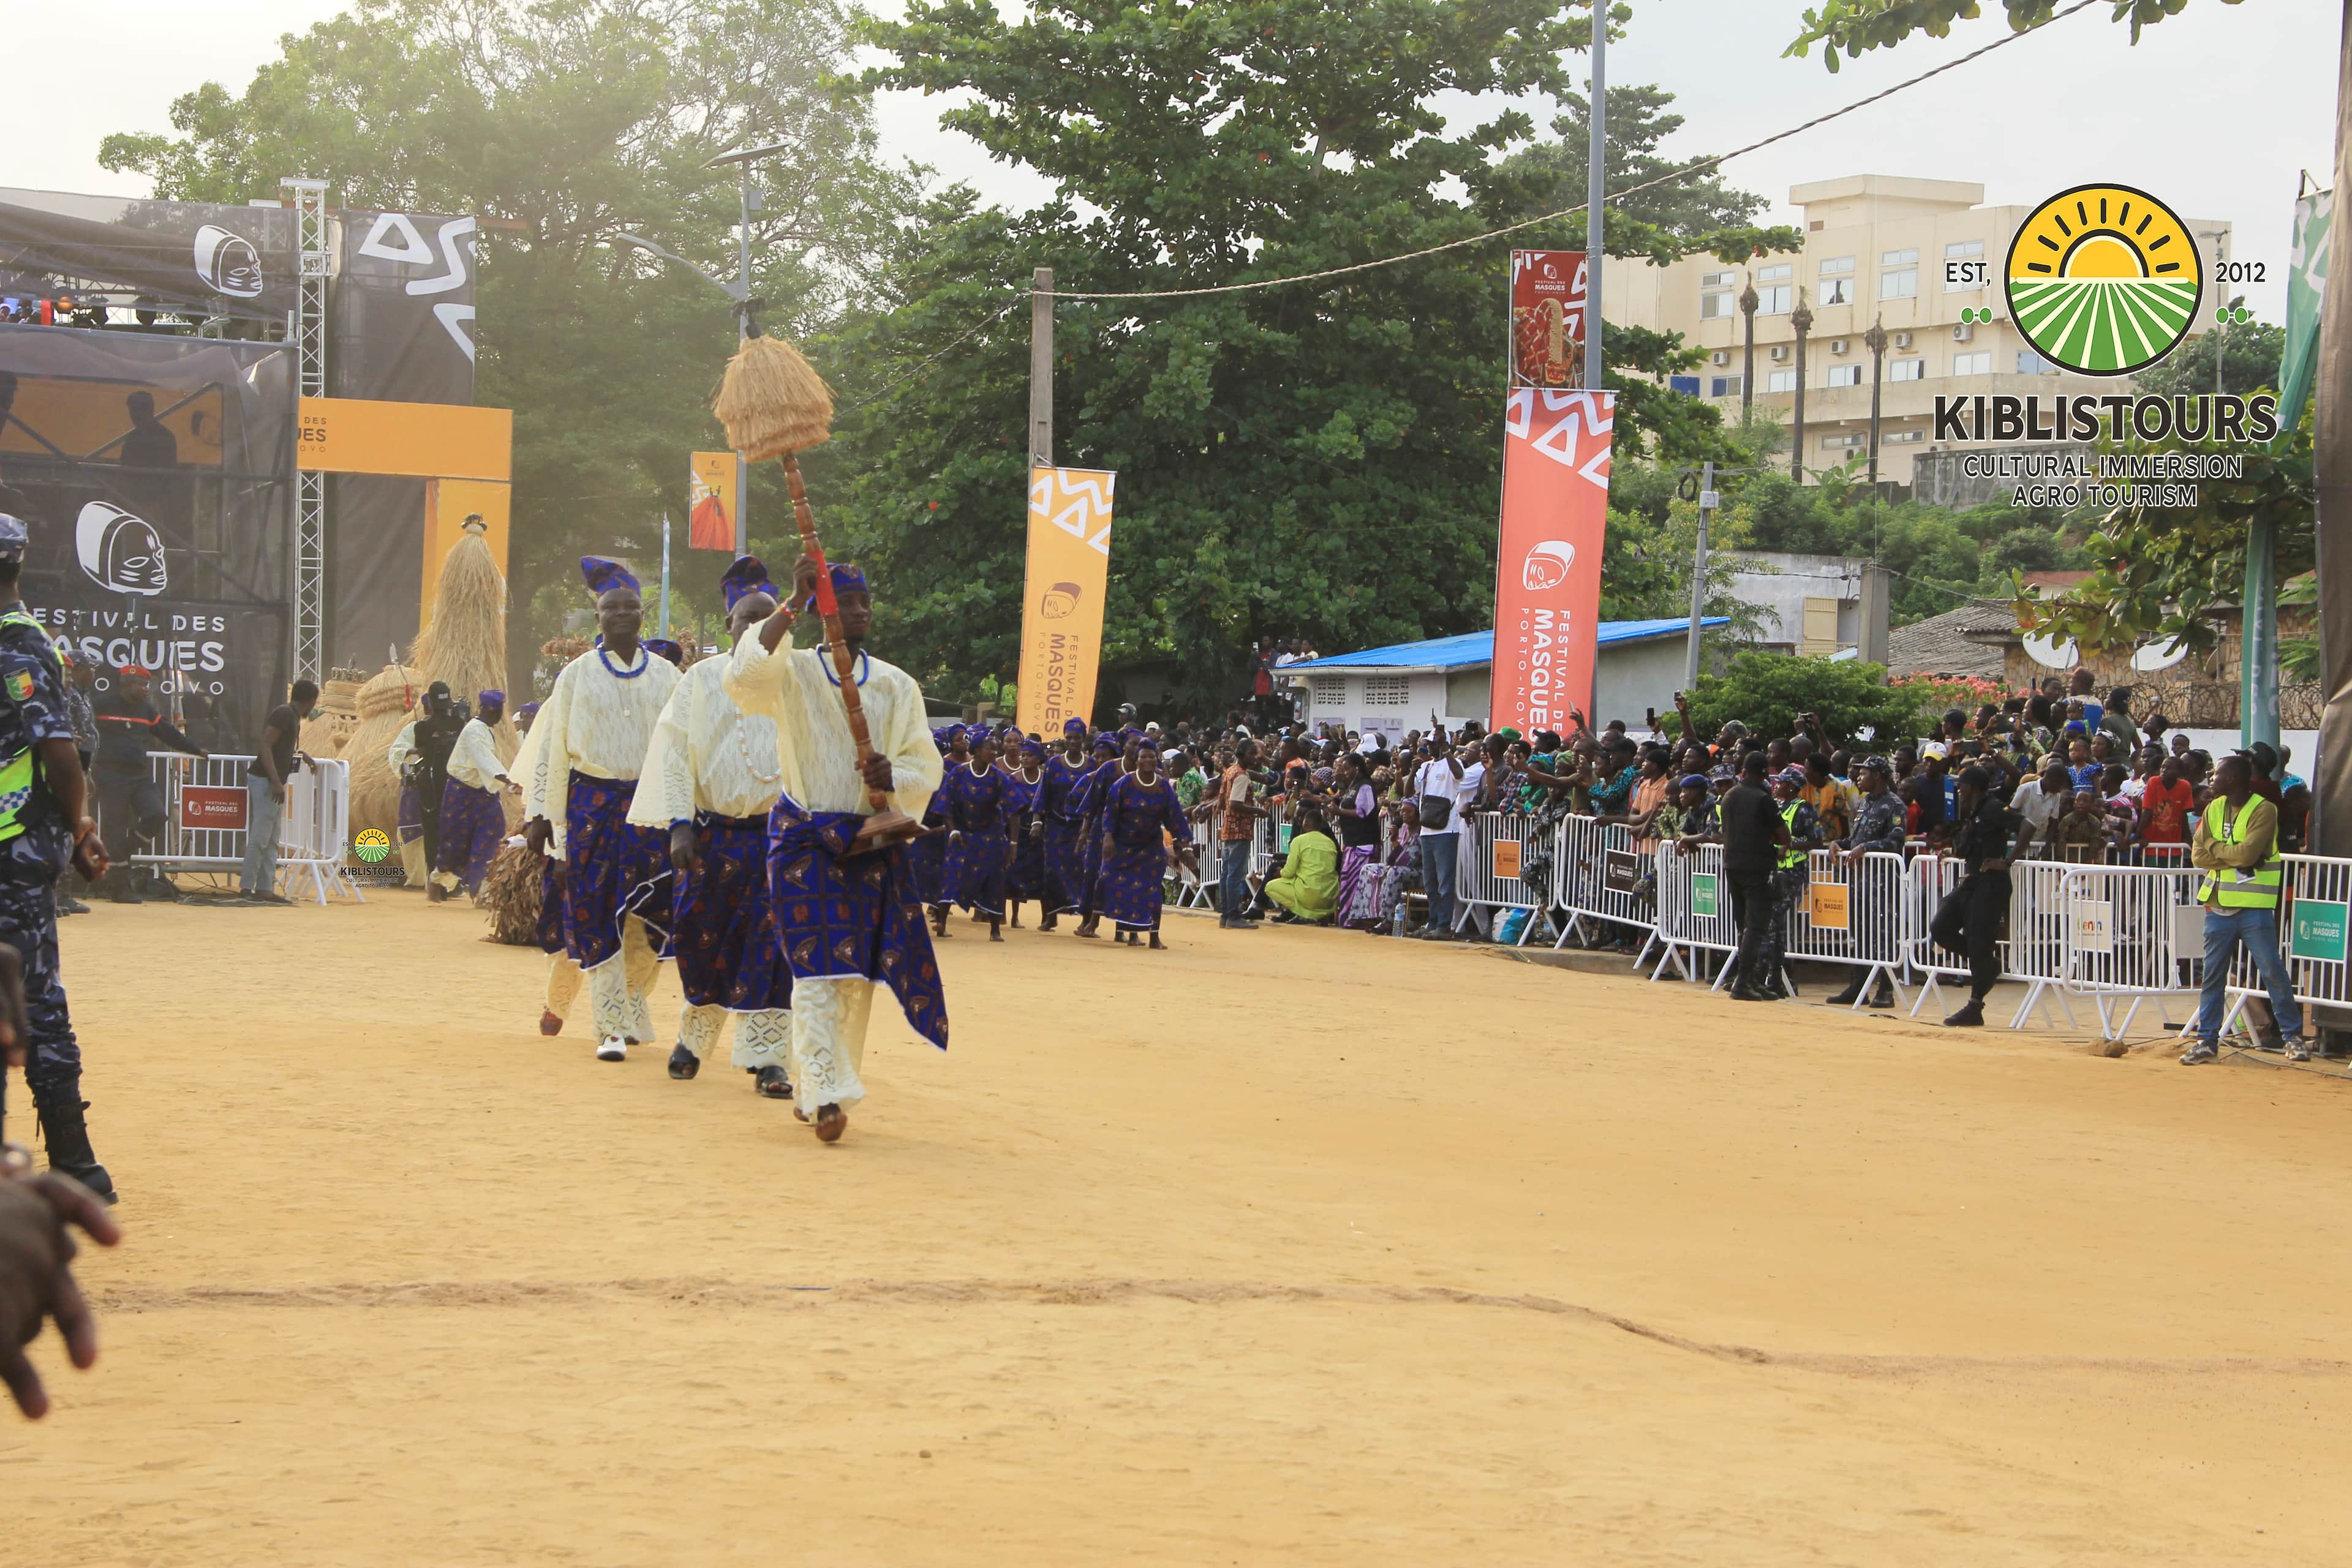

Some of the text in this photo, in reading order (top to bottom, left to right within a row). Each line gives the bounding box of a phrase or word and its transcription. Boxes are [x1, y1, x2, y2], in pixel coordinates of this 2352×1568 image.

[304, 417, 327, 425] DES
[172, 614, 225, 632] DES
[1066, 635, 1079, 703] FESTIVAL
[1554, 609, 1570, 701] FESTIVAL
[1044, 633, 1066, 733] MASQUES
[2312, 927, 2340, 938] MASQUES
